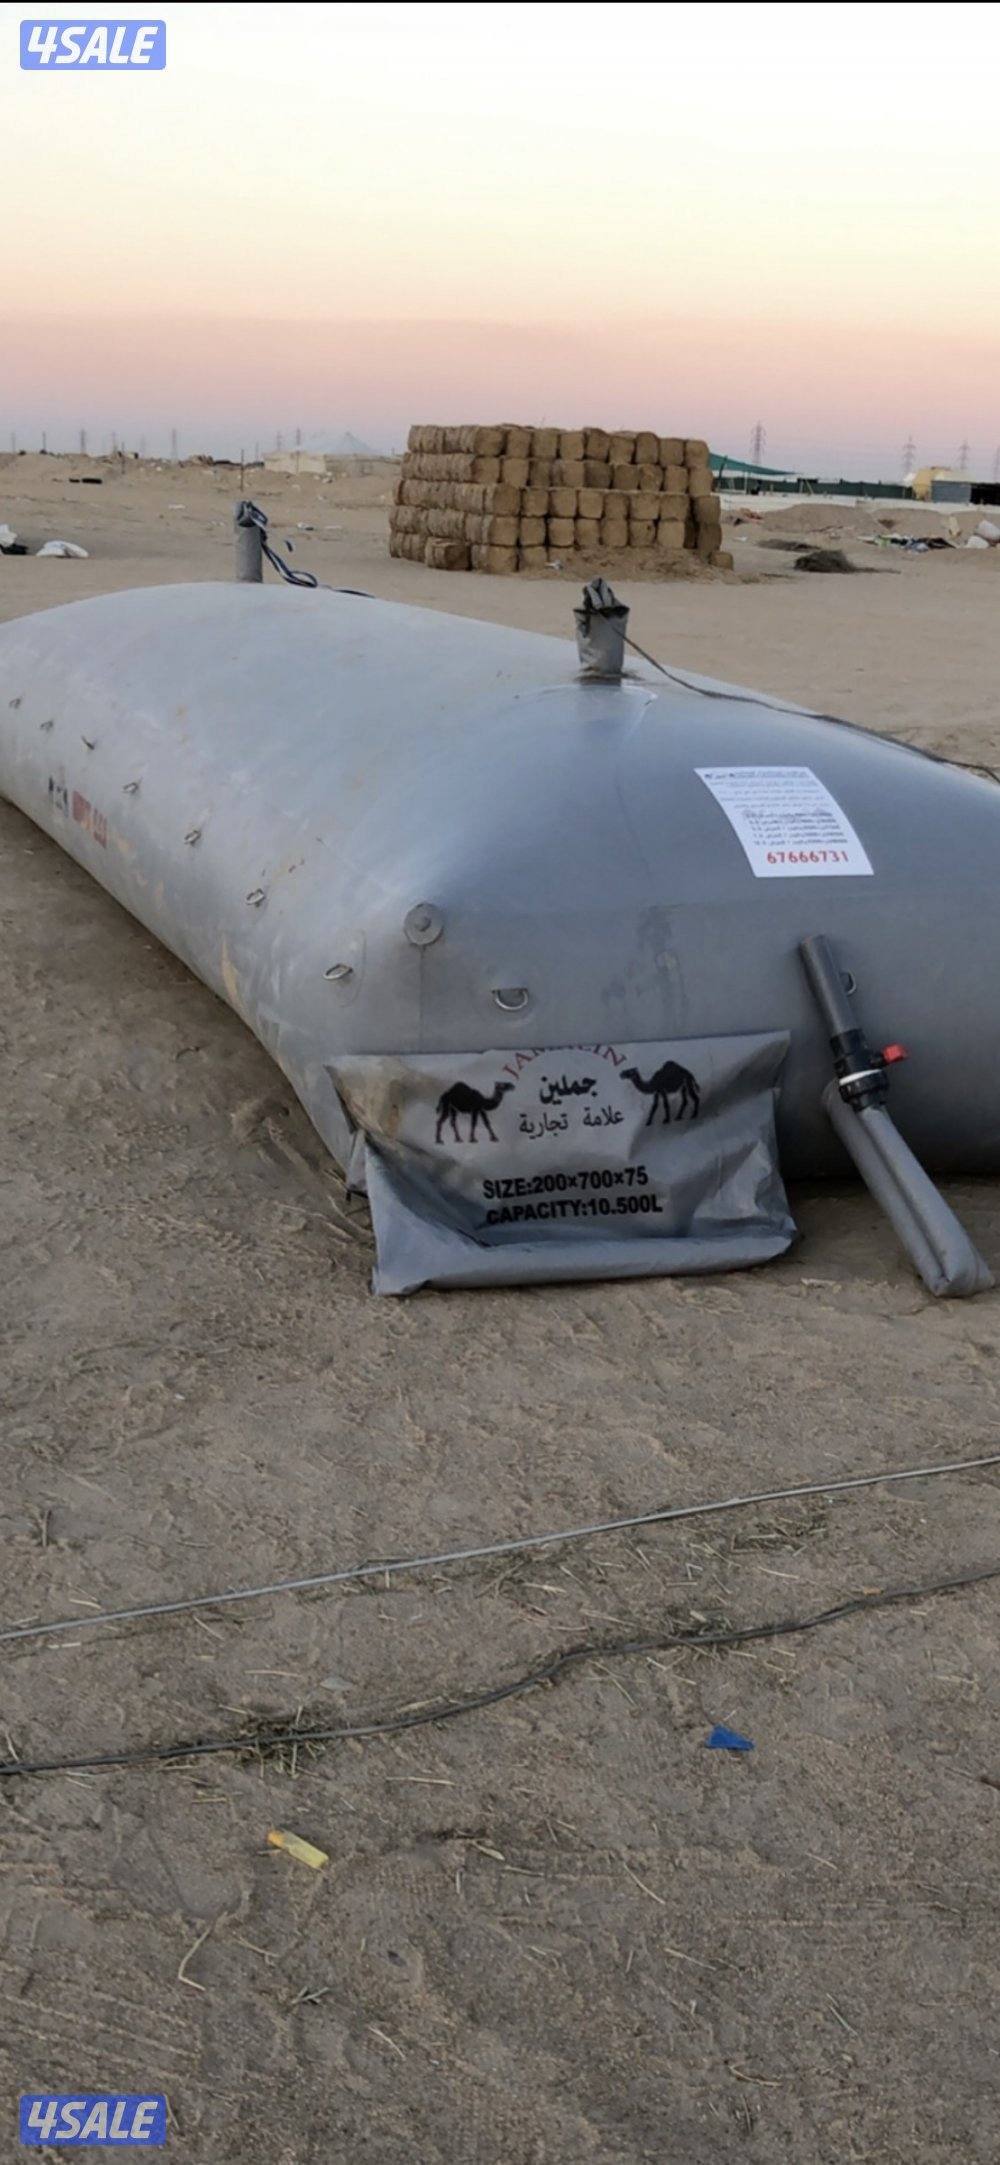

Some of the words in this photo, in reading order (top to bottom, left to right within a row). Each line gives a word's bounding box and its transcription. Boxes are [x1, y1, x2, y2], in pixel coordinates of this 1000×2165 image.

[767, 850, 849, 865] 67666731
[539, 1074, 598, 1105] جملين
[519, 1111, 569, 1139] تجارية
[583, 1105, 625, 1127] علامة
[486, 1194, 663, 1225] CAPACITY:10.500L
